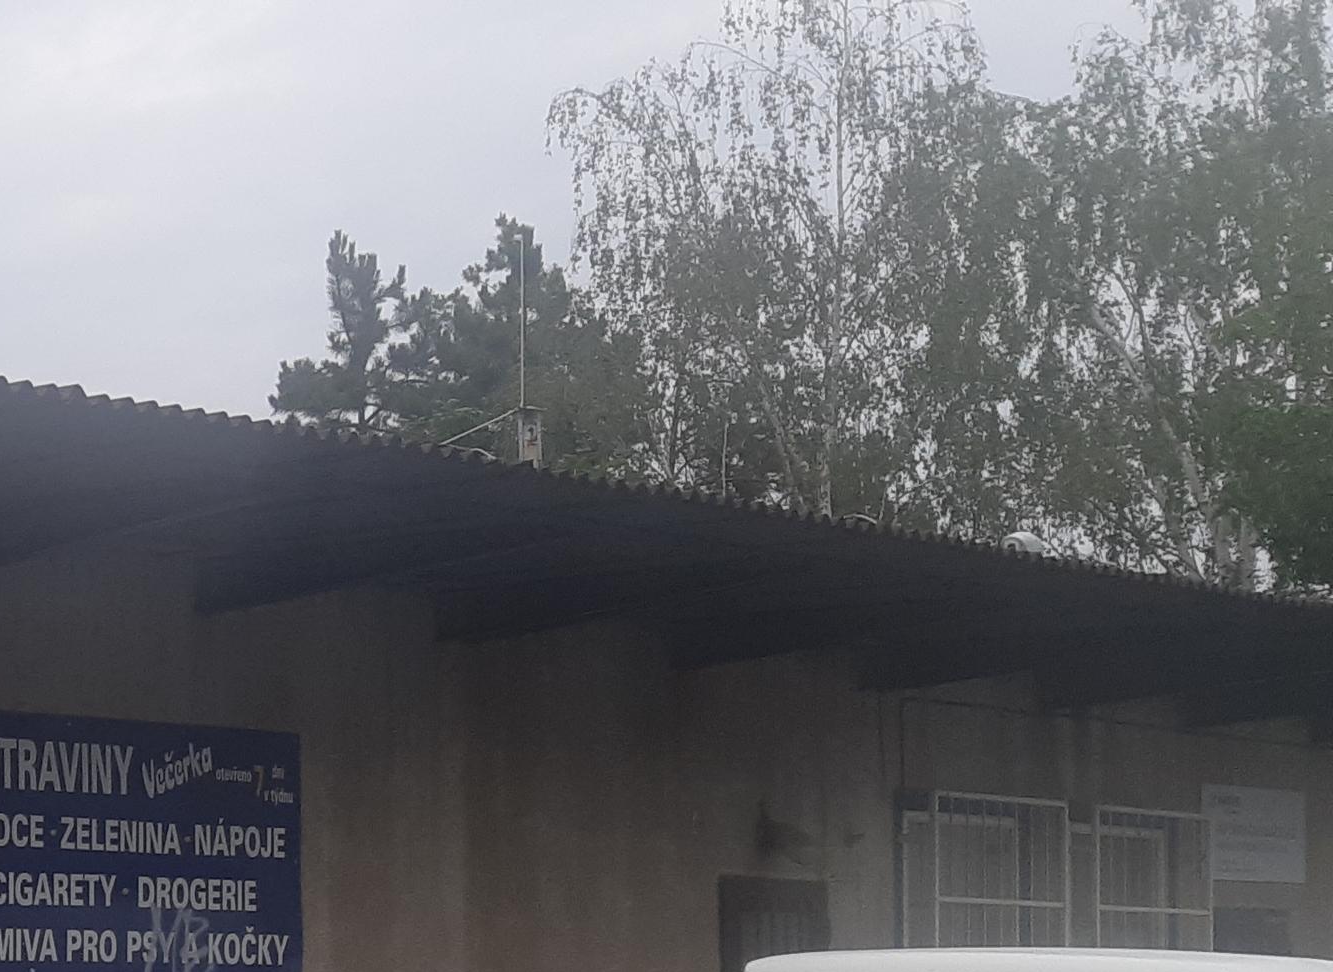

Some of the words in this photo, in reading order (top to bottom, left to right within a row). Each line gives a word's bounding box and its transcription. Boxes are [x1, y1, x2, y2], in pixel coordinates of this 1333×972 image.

[141, 742, 213, 799] Večerka
[253, 764, 266, 798] 7
[60, 816, 182, 856] ZELENINA
[194, 817, 287, 859] NÁPOJE
[137, 876, 258, 912] DROGERIE
[66, 929, 118, 963] PRO
[126, 930, 176, 964] PSY
[181, 932, 200, 965] A
[207, 925, 290, 967] KOČKY
